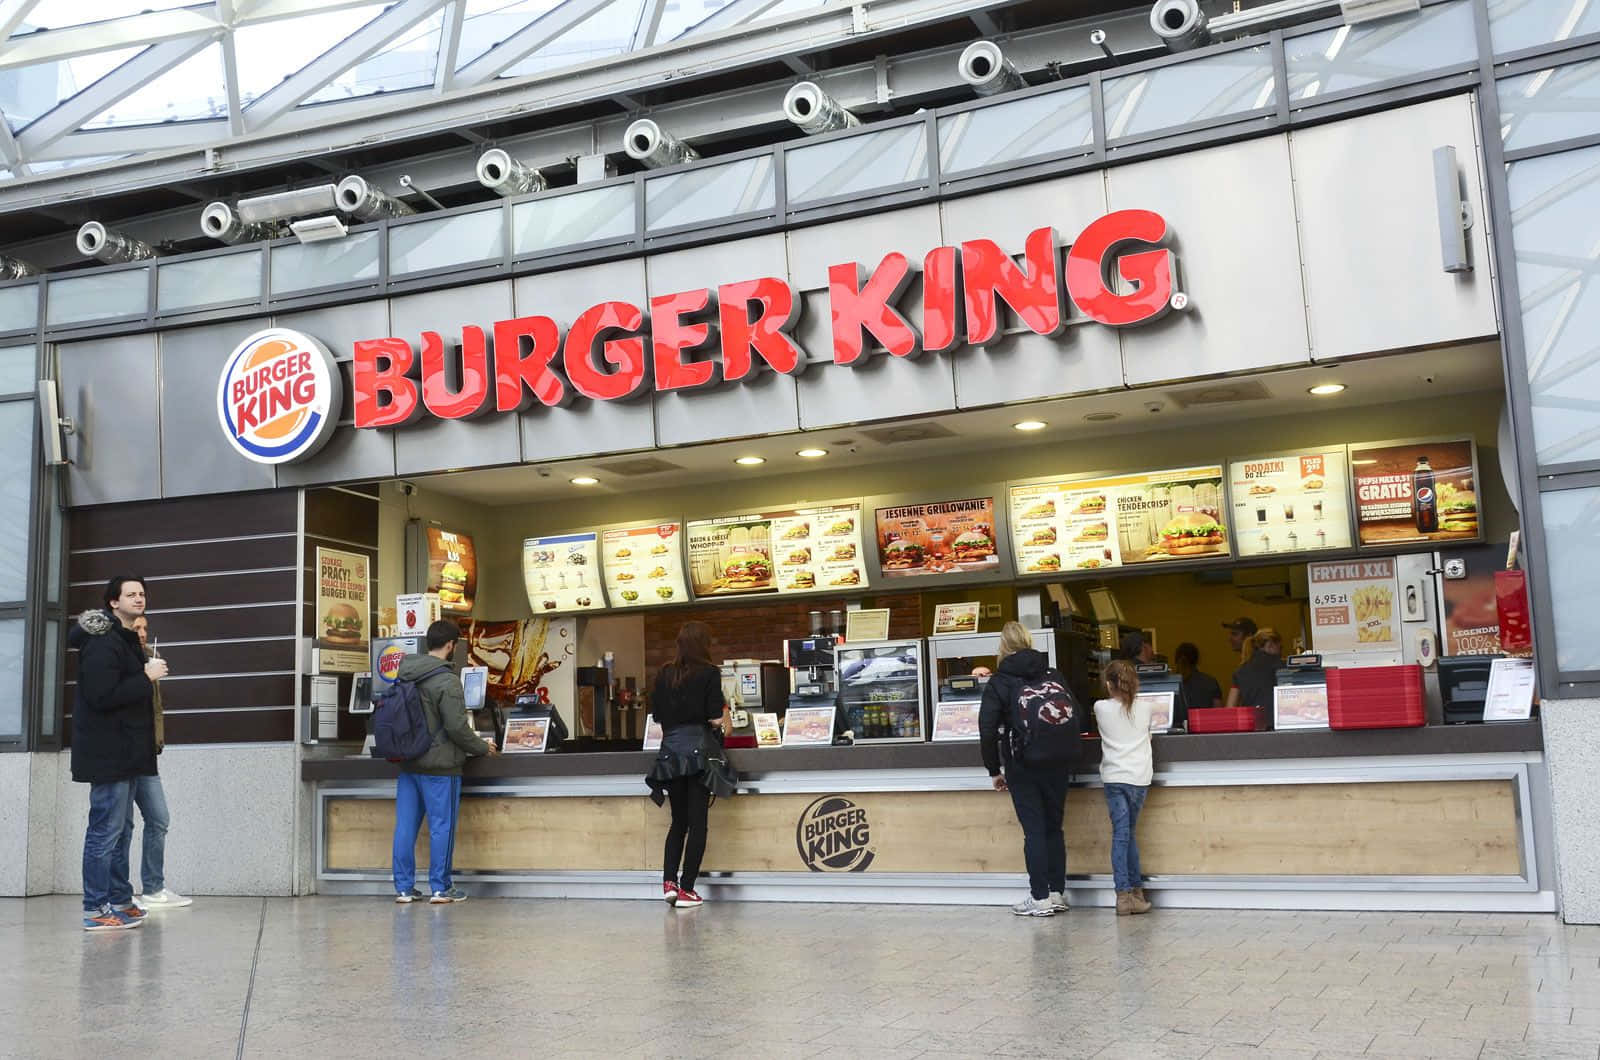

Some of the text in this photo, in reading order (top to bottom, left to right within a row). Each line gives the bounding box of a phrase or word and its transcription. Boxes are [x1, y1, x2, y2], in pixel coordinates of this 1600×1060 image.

[353, 276, 800, 429] BURGER
[828, 208, 1173, 365] KING
[233, 351, 312, 405] BURGER
[237, 372, 316, 436] KING
[1244, 461, 1284, 473] DODATKI
[1117, 495, 1142, 503] CHICKEN
[1358, 483, 1412, 500] GRATIS
[886, 500, 985, 519] JESIENNE GRILLOWANIE
[1117, 500, 1169, 511] TENDERCRISP
[321, 566, 351, 581] PRACY?
[1312, 561, 1391, 580] FRYTKI XXL
[321, 587, 347, 599] BURGER
[1315, 594, 1337, 605] 6,95
[1456, 635, 1492, 651] 100%
[805, 808, 867, 841] BURGER
[808, 823, 870, 863] KING
